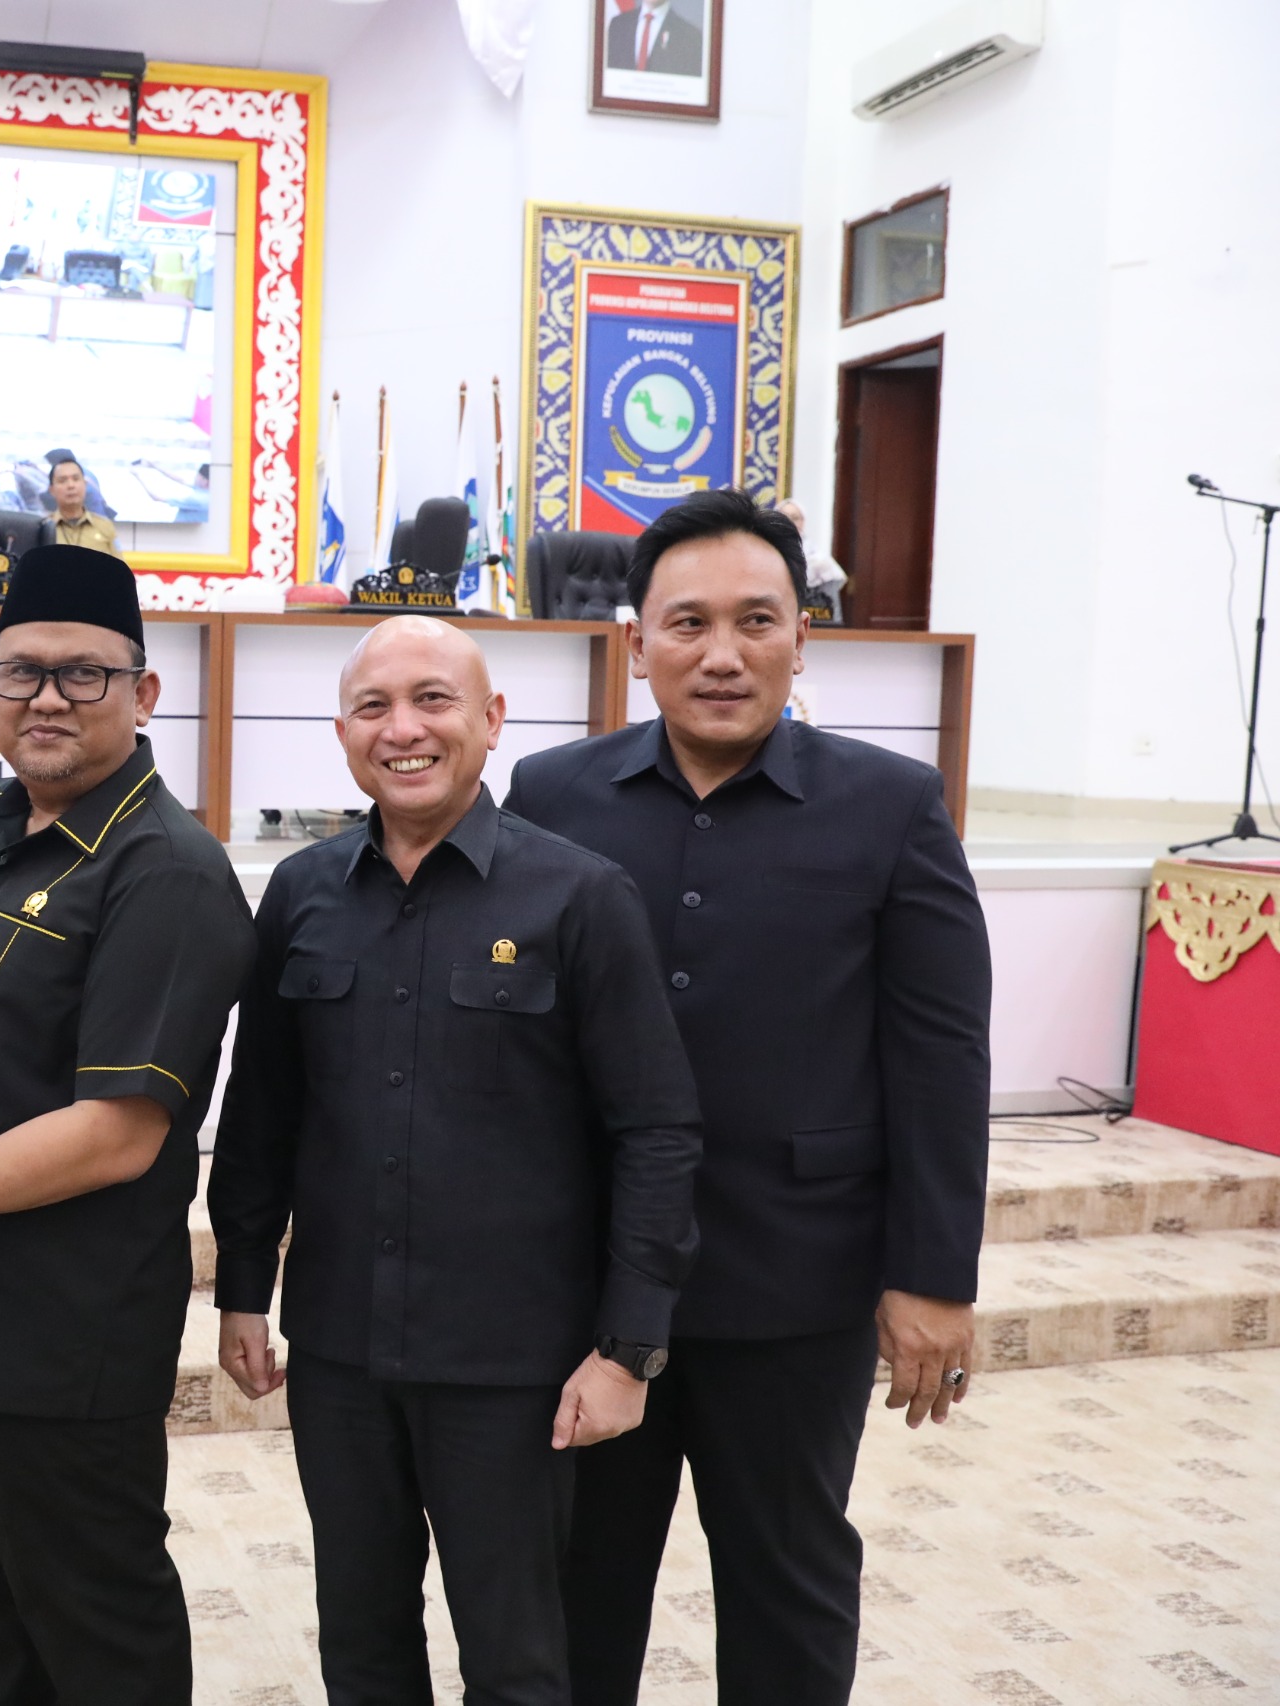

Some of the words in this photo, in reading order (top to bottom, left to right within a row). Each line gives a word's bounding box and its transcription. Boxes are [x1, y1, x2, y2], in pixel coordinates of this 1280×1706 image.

[627, 328, 694, 345] PROVINSI
[643, 349, 690, 369] BANGKA
[357, 591, 403, 605] WAKIL
[407, 592, 453, 606] KETUA
